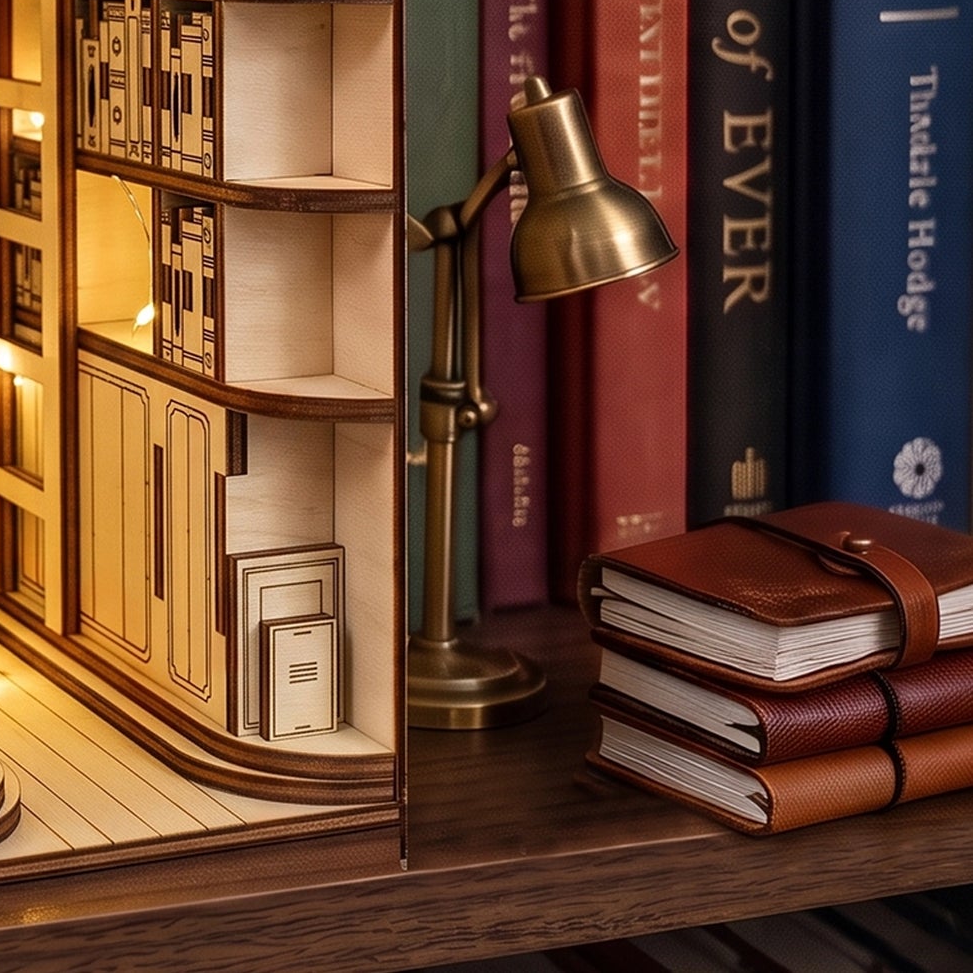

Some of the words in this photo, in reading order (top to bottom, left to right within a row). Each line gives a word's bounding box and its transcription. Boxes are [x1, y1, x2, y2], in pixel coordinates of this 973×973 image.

[712, 11, 770, 78] of
[723, 111, 770, 311] EVER
[897, 220, 935, 333] Hodge
